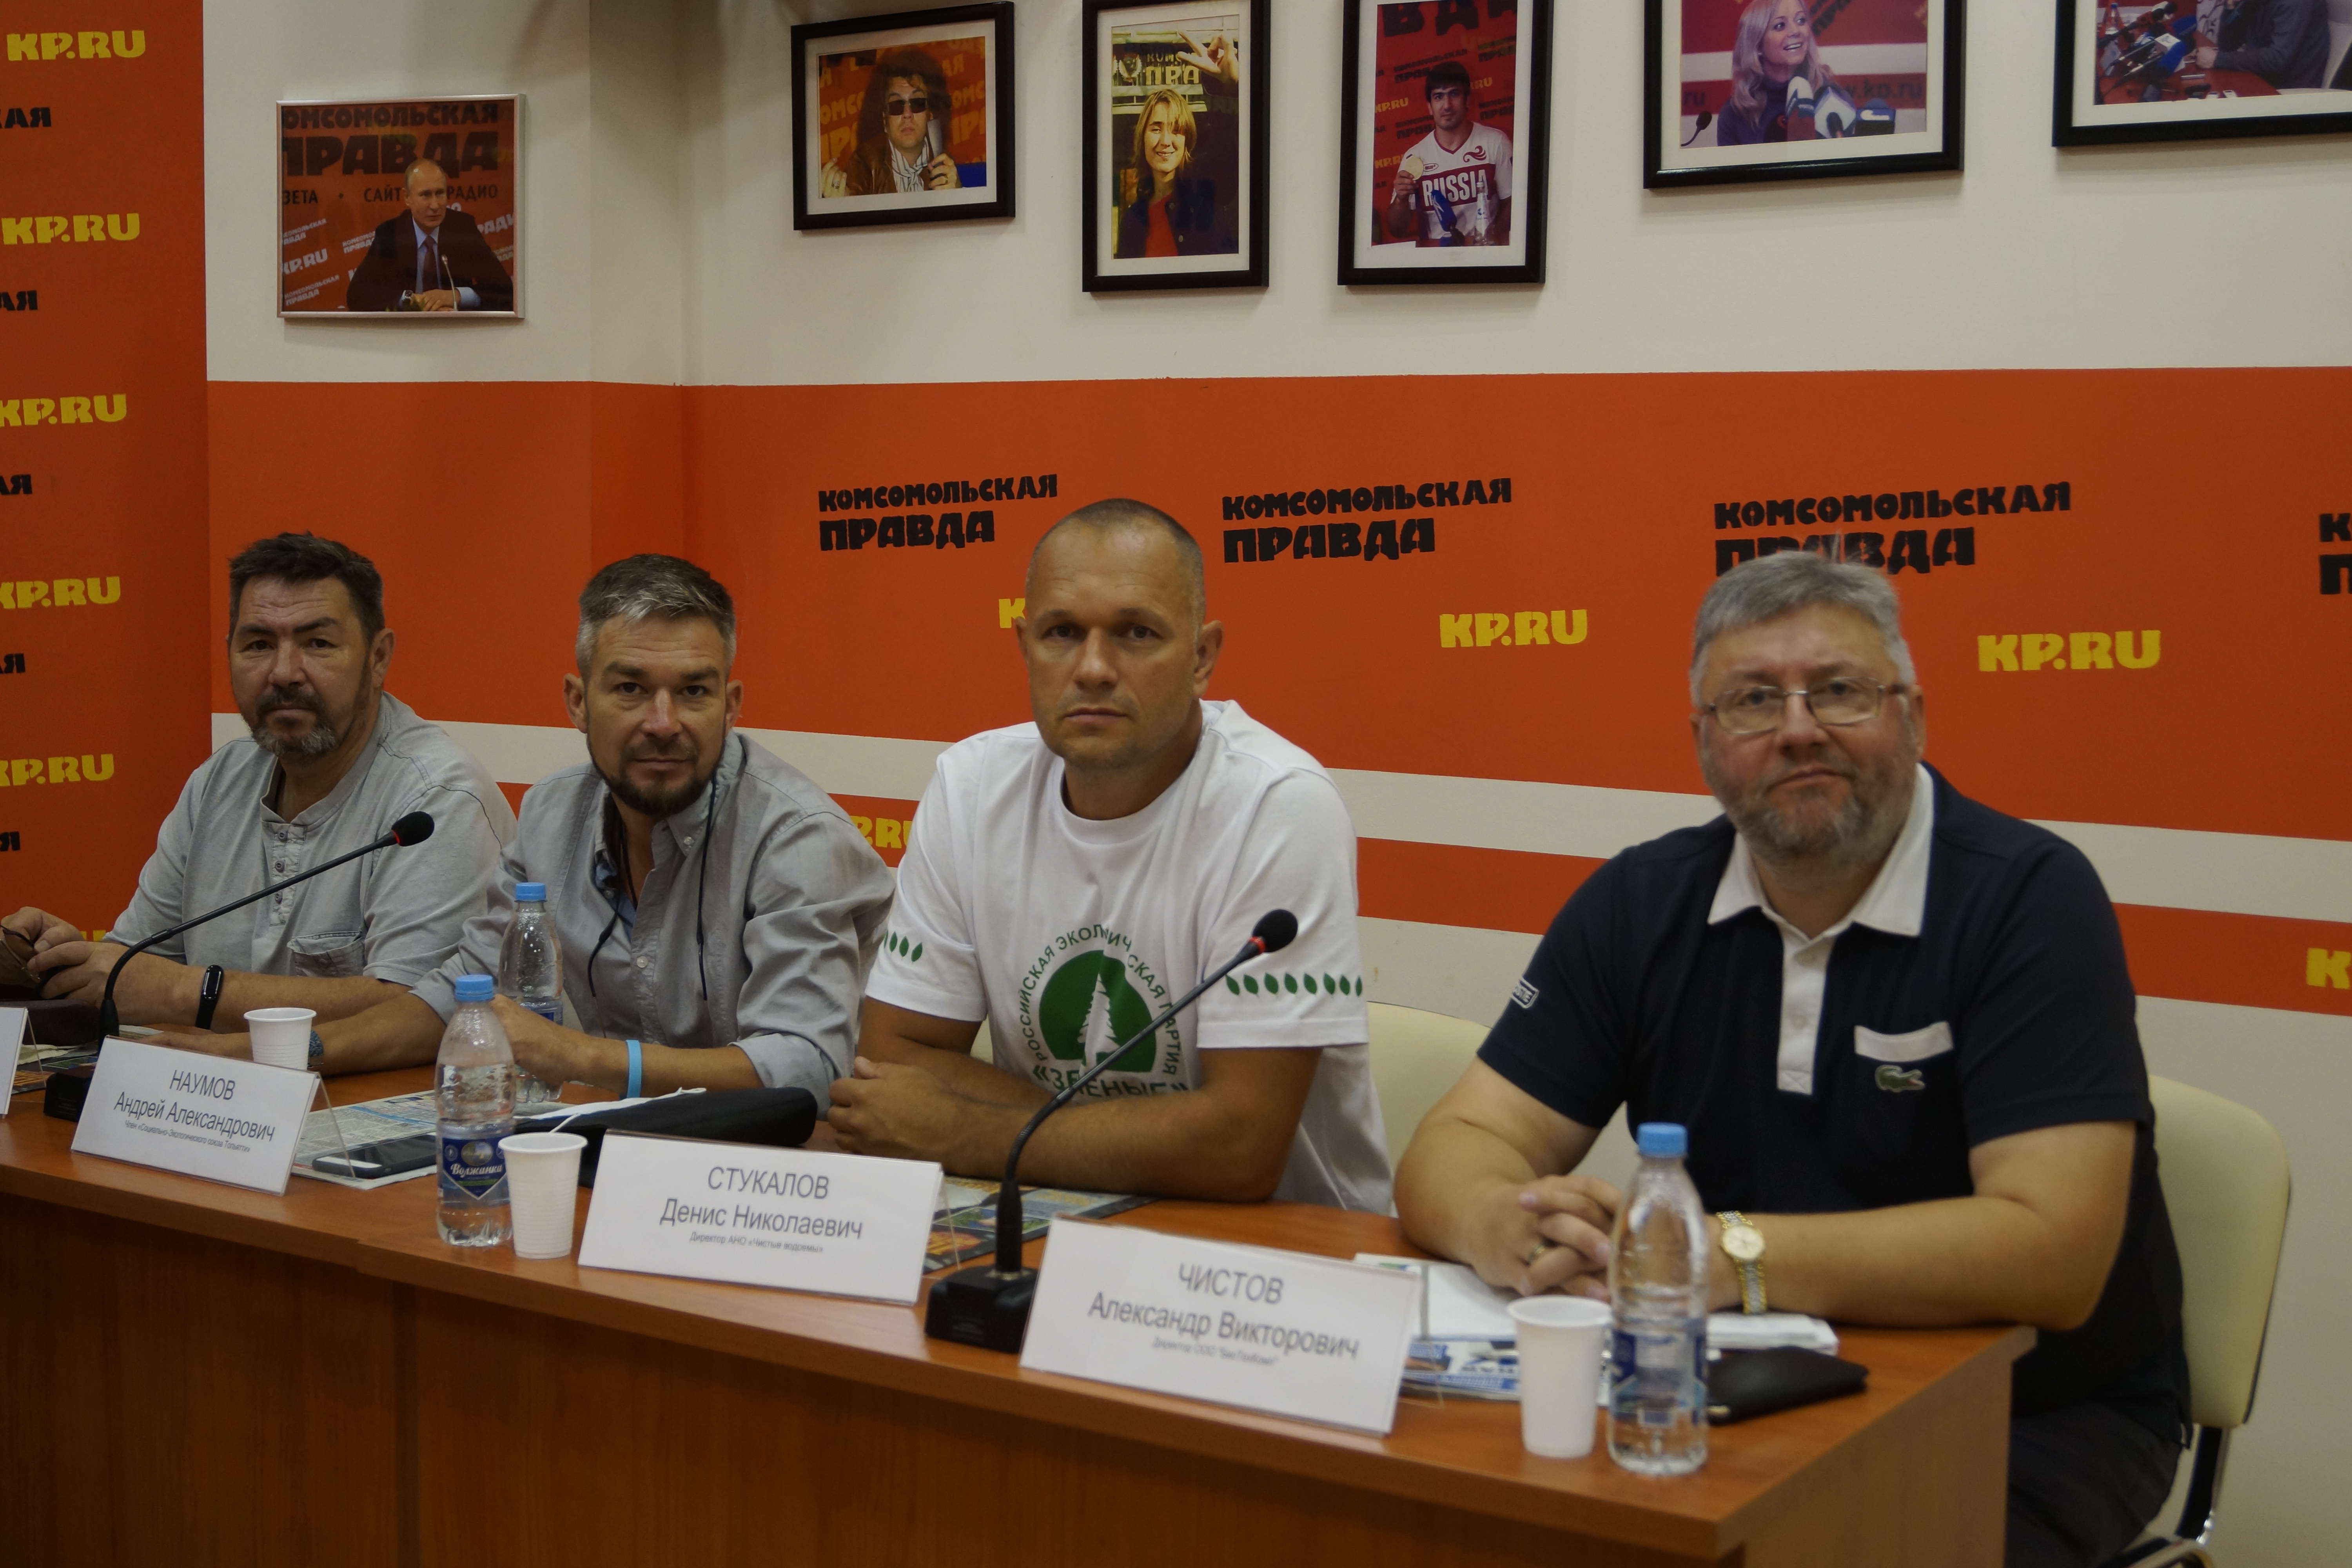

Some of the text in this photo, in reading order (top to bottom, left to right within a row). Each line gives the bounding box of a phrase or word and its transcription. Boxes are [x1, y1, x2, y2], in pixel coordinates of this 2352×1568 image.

[7, 30, 145, 61] KP.RU
[447, 184, 498, 202] РАДИО
[1422, 169, 1488, 207] RUSSIA
[1, 213, 140, 245] KP.RU
[0, 394, 127, 427] KP.RU
[818, 474, 1057, 512] КОМСОМОЛЬСКАЯ
[1222, 477, 1512, 521] КОМСОМОЛЬСКАЯ
[1713, 481, 2071, 530] КОМСОМОЛЬСКАЯ
[820, 510, 995, 551] ПРАВДА
[1223, 518, 1435, 563] ПРАВДА
[1439, 609, 1588, 648] KP.RU
[1978, 630, 2161, 671] KP.RU
[1018, 945, 1055, 1061] РОССИЙСКАЯ
[169, 1069, 236, 1100] НАУМОВ
[113, 1091, 166, 1120] Андрей
[165, 1102, 276, 1142] Александрович
[707, 1165, 830, 1200] СТУКАЛОВ
[659, 1198, 864, 1240] Денис Николаевич
[689, 1230, 726, 1245] Директор
[728, 1235, 746, 1246] АНО
[1178, 1263, 1285, 1305] ЧИСТОВ
[1087, 1291, 1211, 1339] Александр
[1217, 1310, 1360, 1361] Викторович
